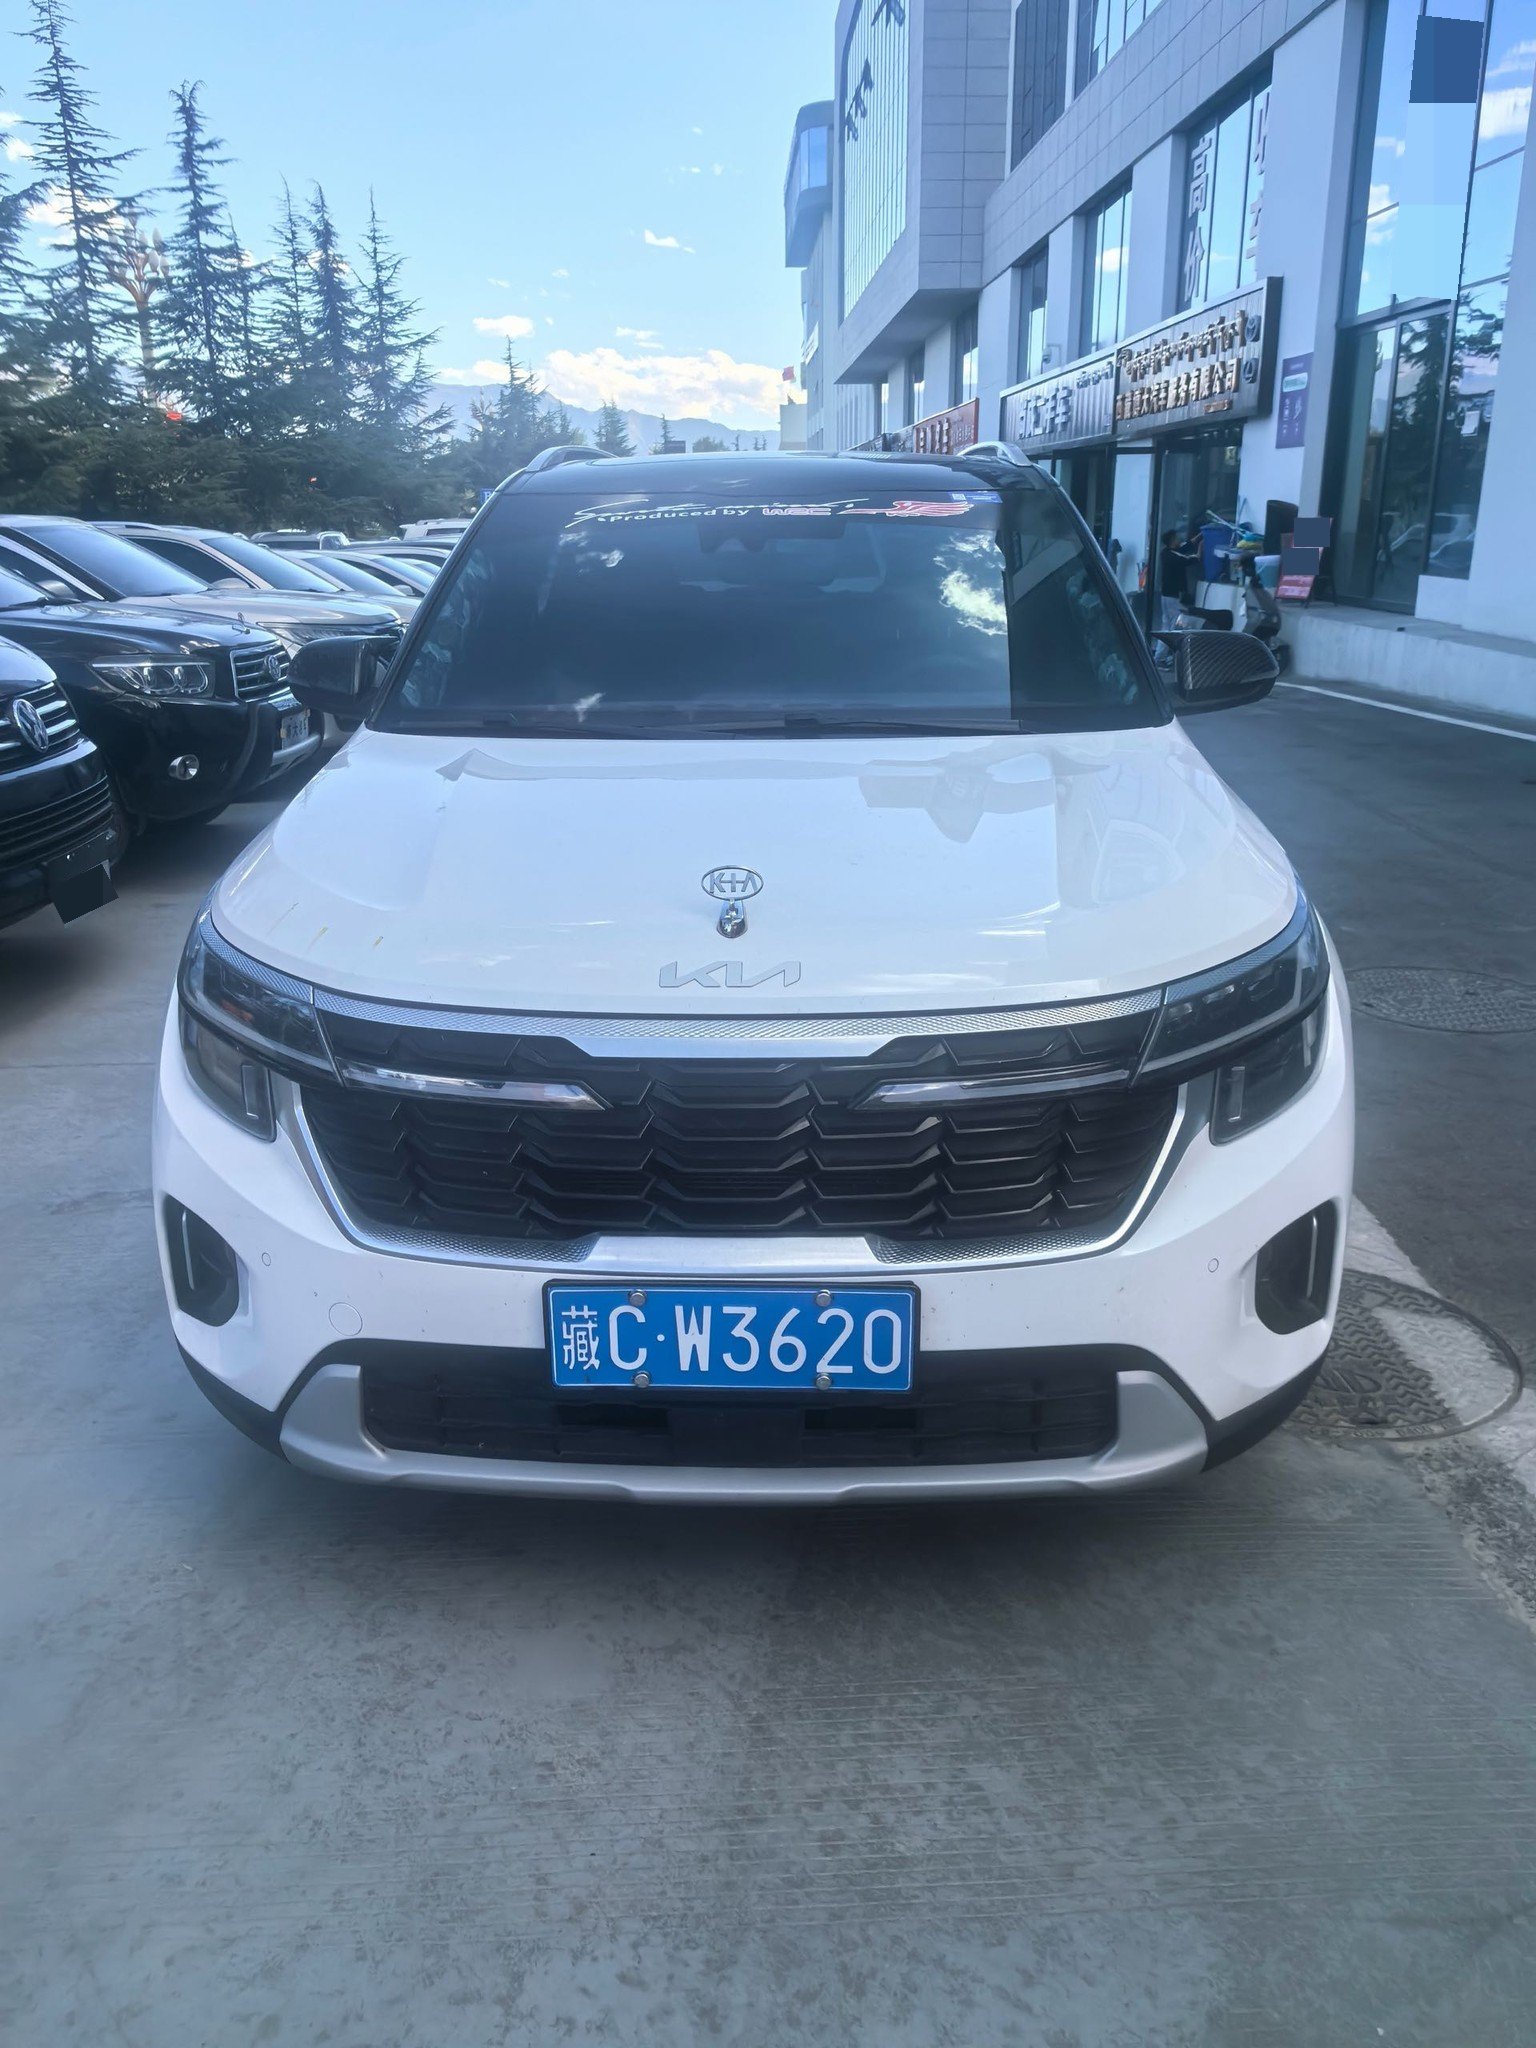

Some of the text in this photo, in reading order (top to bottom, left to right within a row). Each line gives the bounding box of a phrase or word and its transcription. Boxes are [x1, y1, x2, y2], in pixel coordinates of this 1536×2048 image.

[722, 508, 750, 517] by
[709, 872, 759, 895] KIA
[659, 961, 801, 988] KIA
